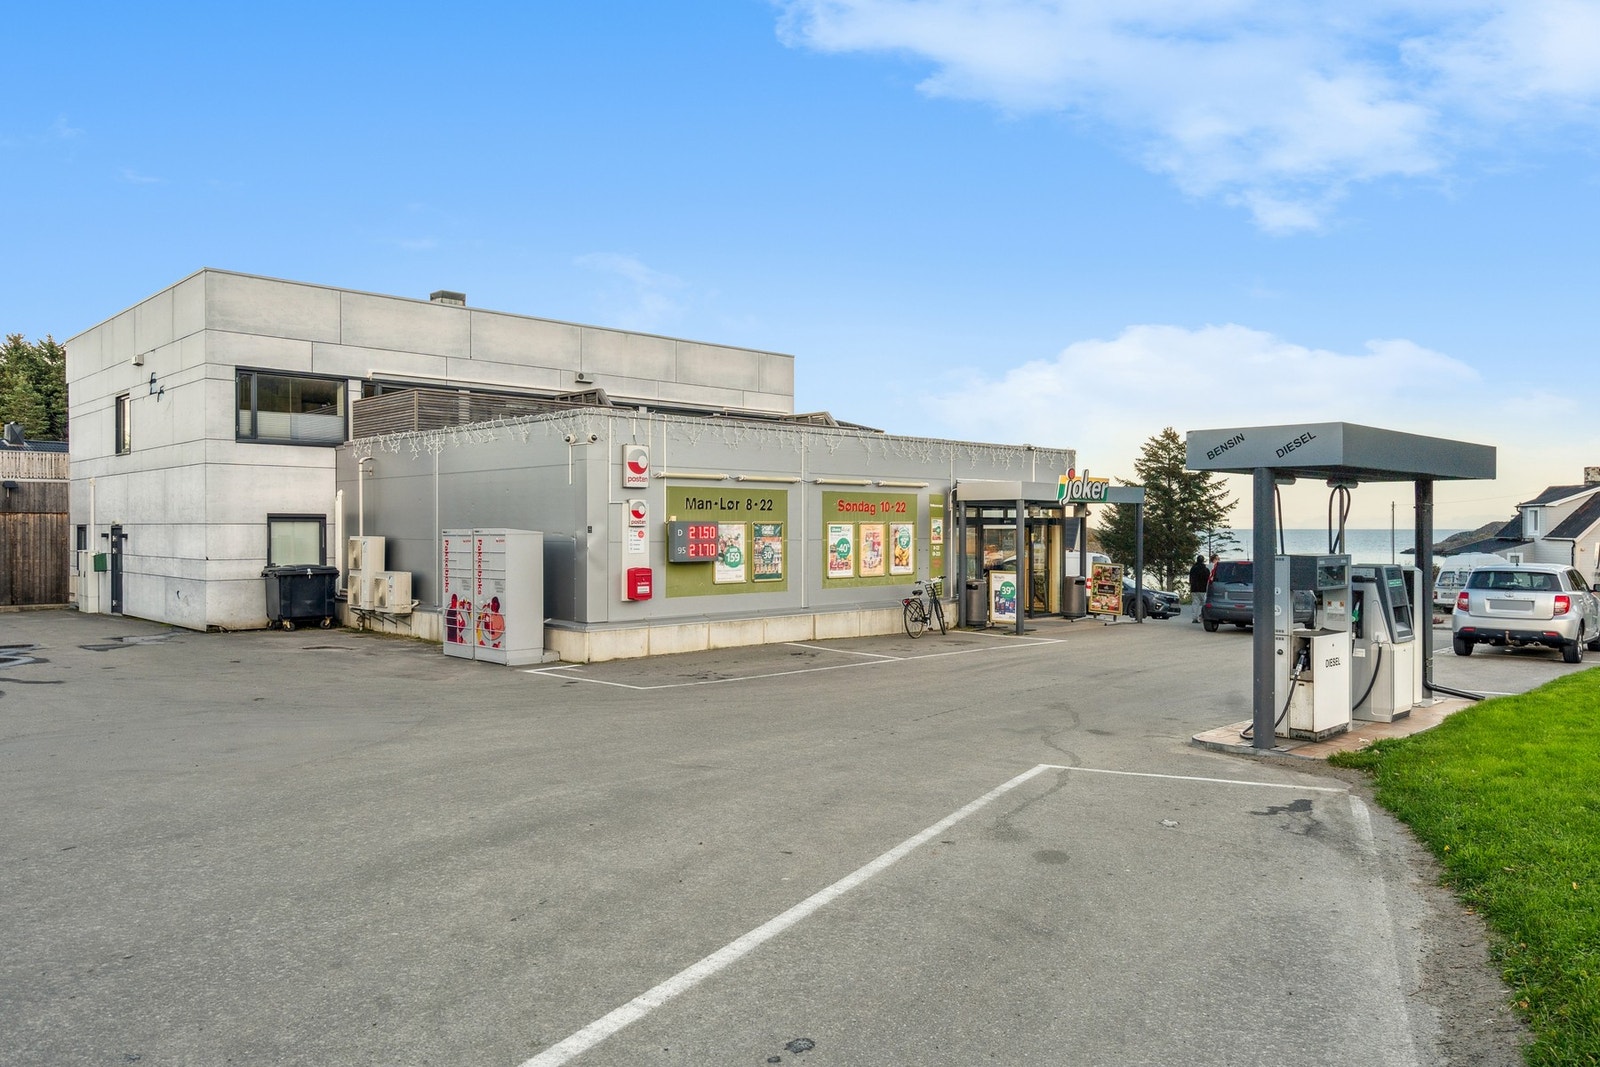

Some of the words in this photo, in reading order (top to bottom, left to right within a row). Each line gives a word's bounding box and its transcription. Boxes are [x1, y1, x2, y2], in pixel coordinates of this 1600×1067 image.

[1206, 433, 1245, 460] BENSIN
[1275, 431, 1317, 458] DIESEL
[1060, 467, 1109, 505] joker
[838, 499, 876, 516] Søndag
[677, 528, 684, 537] D
[677, 546, 687, 555] 95
[726, 552, 740, 563] 159
[1325, 656, 1341, 669] DIESEL
